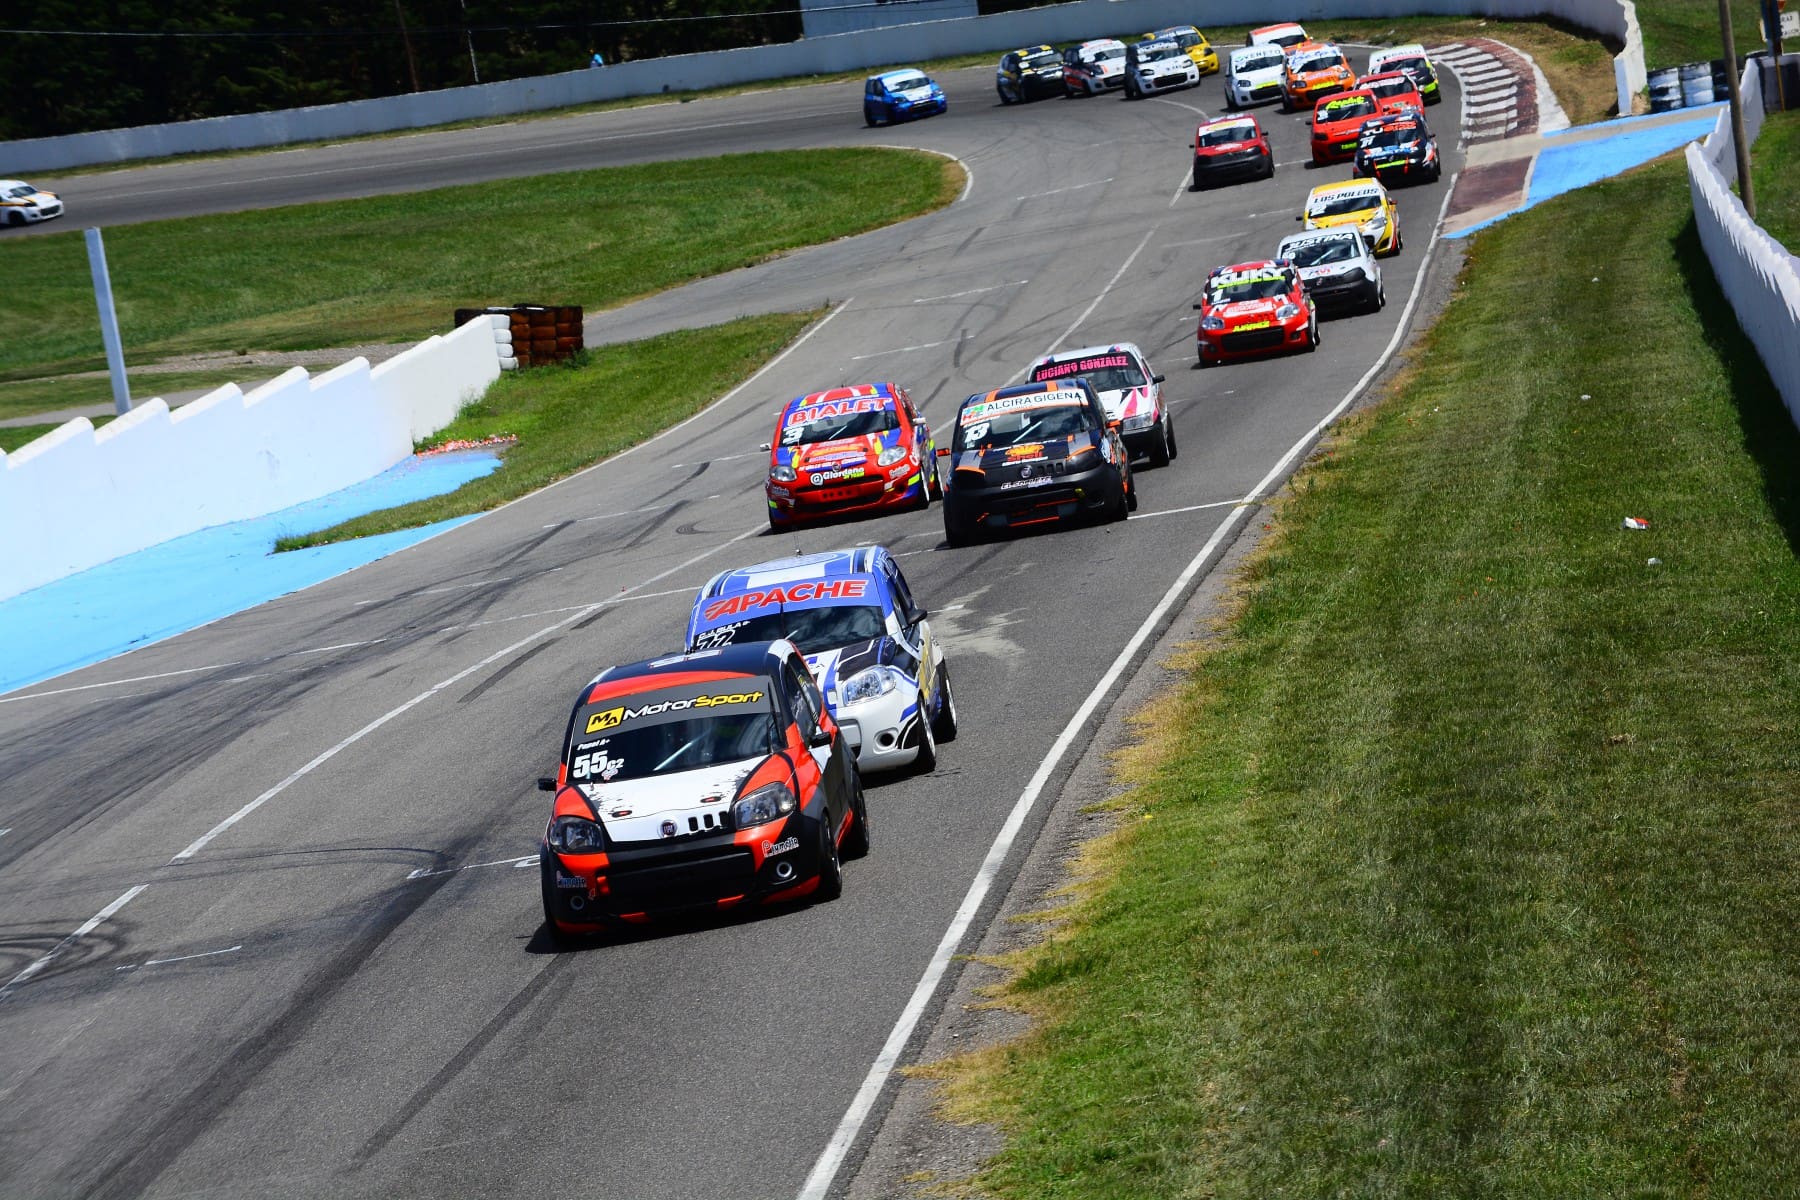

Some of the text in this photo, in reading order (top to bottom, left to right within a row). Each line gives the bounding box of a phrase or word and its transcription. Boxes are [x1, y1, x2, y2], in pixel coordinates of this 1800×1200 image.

[1211, 289, 1224, 304] 1
[1036, 355, 1129, 382] LUCIANO GONZALEZ
[787, 397, 894, 427] BIALET
[986, 391, 1082, 412] ALCIRA GIGENA
[782, 426, 804, 444] 3
[704, 579, 870, 622] APACHE
[622, 690, 764, 721] MotorSport
[572, 750, 608, 779] 55
